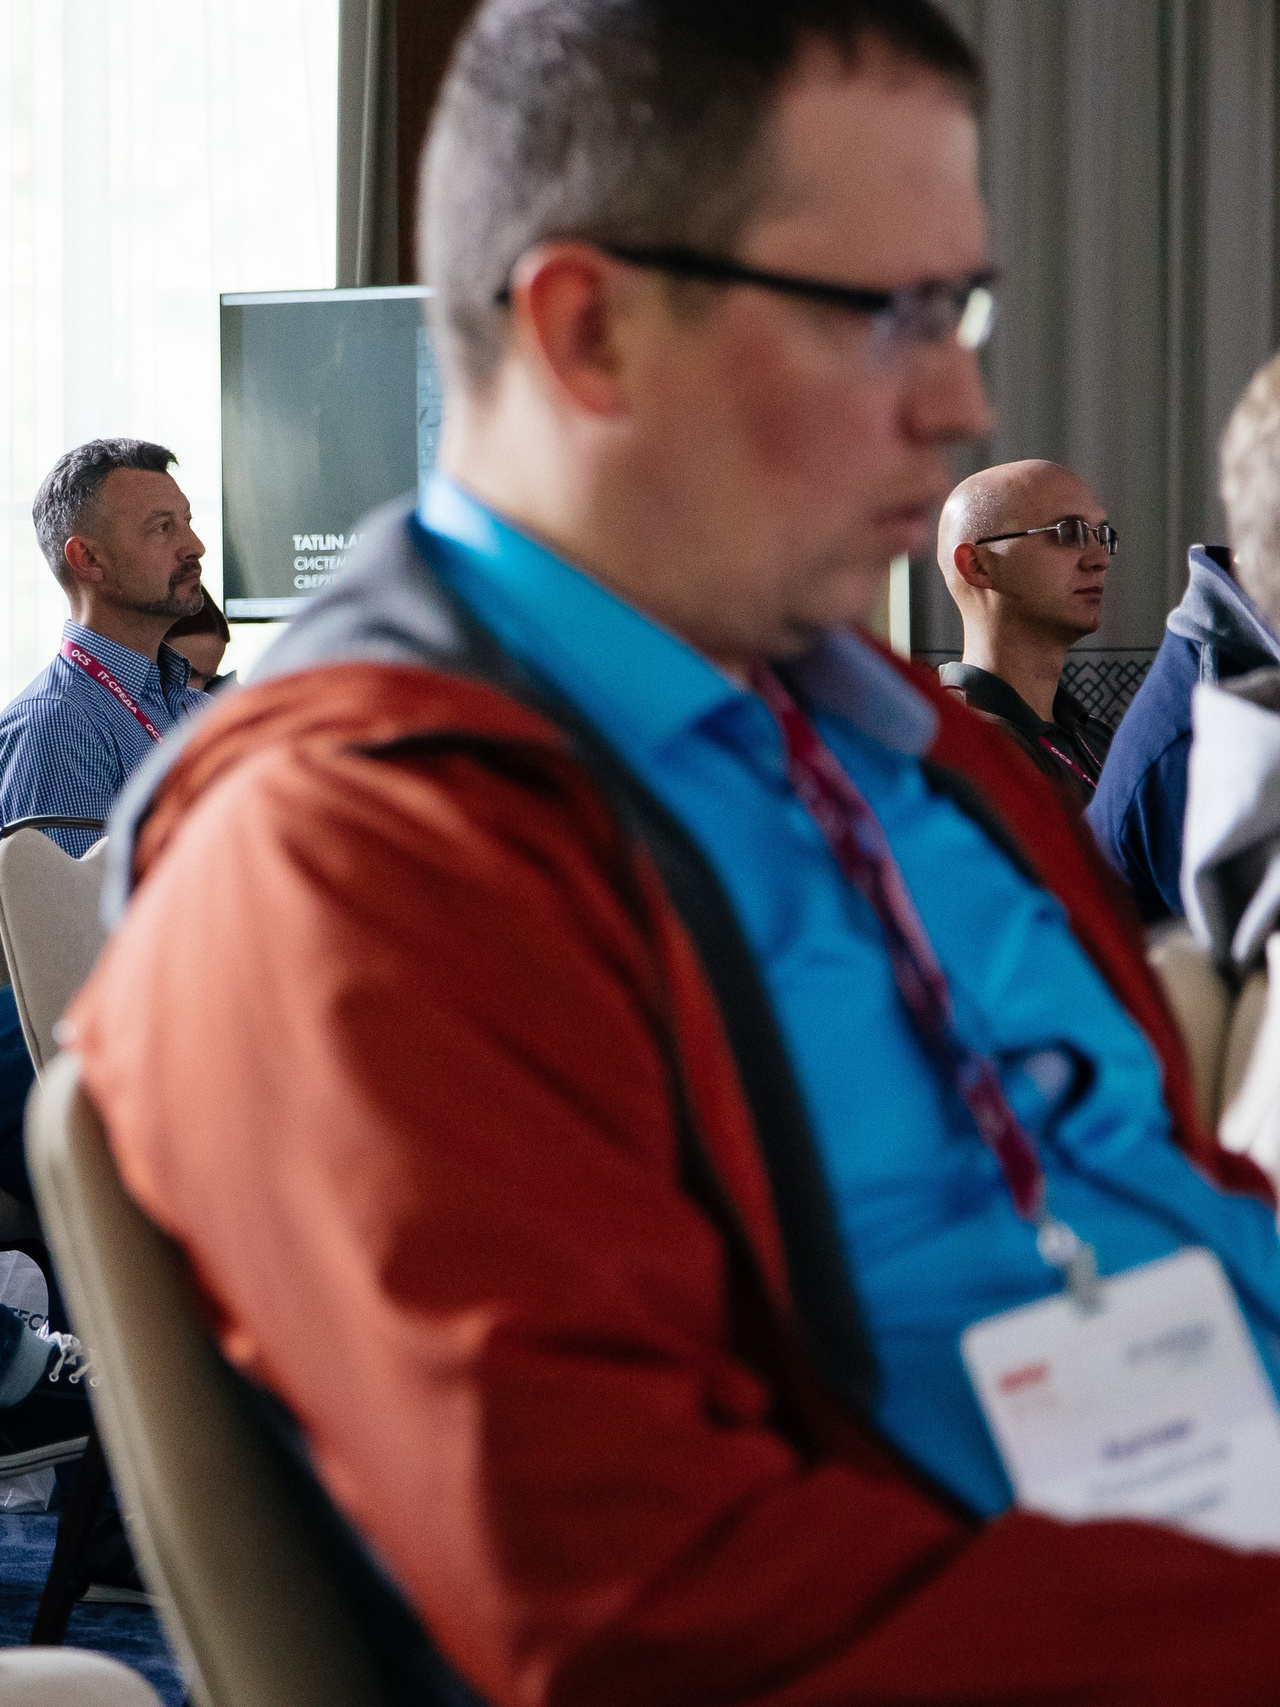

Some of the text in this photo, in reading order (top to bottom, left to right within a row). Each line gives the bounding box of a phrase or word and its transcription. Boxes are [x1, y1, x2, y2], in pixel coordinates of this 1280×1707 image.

[292, 533, 363, 551] TATLIN.A
[71, 649, 92, 667] OCS
[97, 670, 138, 714] IT-СРЕДА
